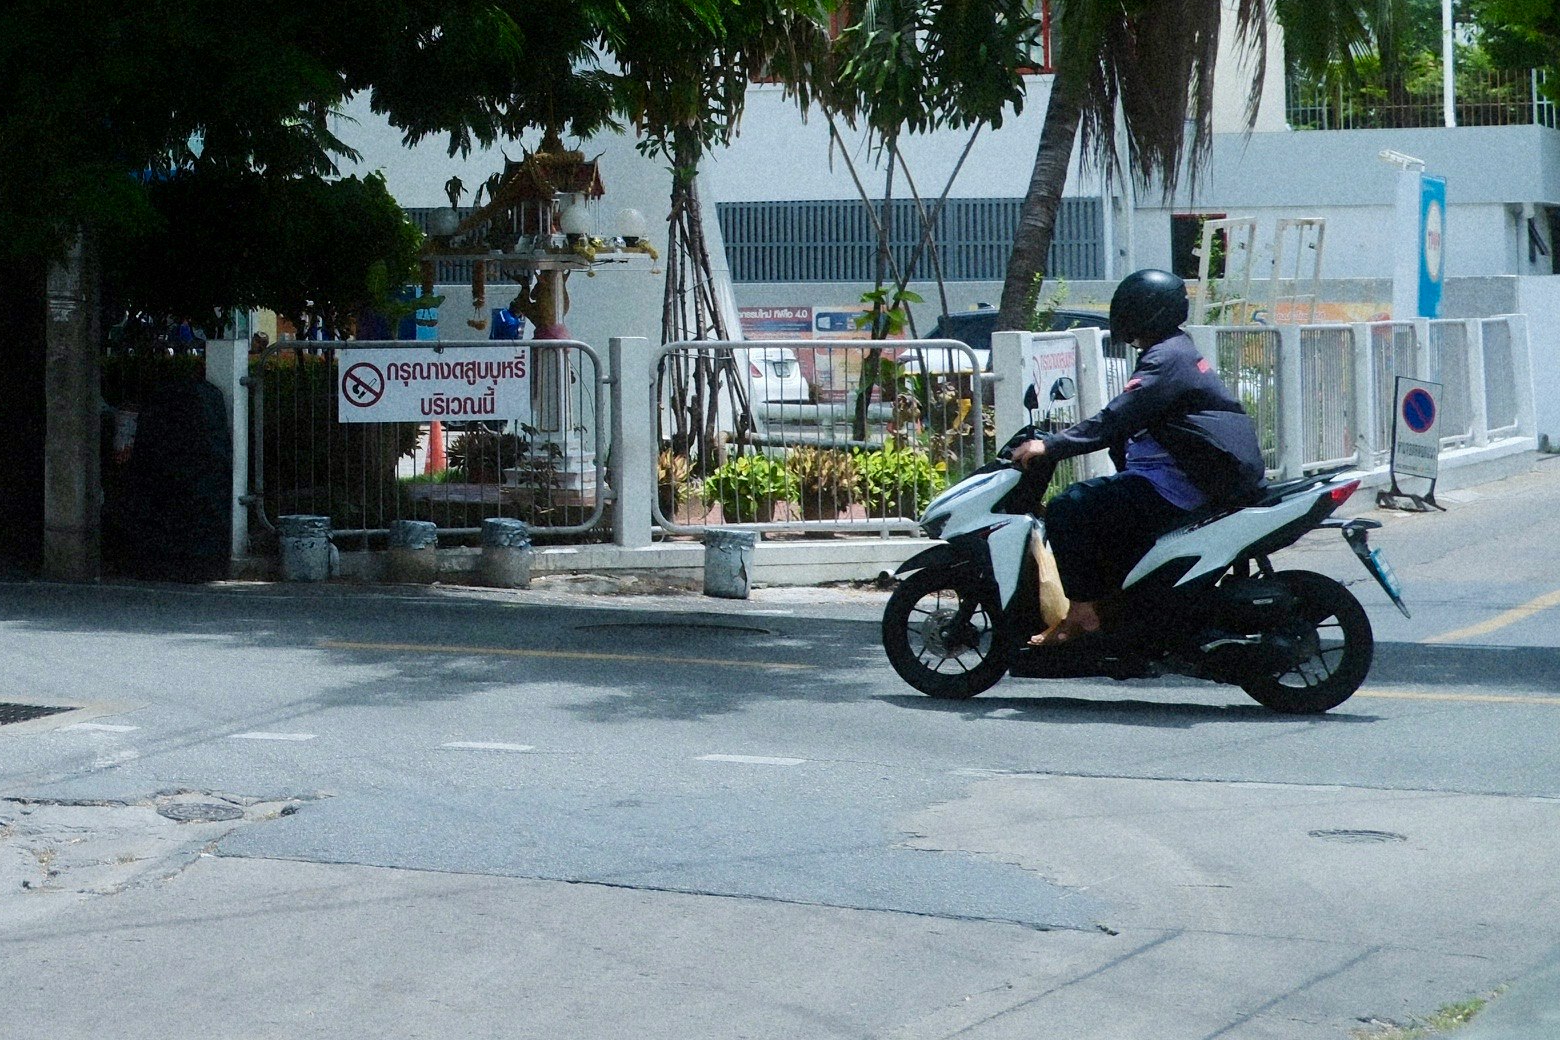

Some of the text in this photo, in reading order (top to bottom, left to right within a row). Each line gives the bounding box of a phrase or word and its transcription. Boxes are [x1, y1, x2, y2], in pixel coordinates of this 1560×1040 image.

[387, 349, 526, 387] กรุณางดสูบบุหรี่
[420, 386, 495, 416] บริเวณนี้
